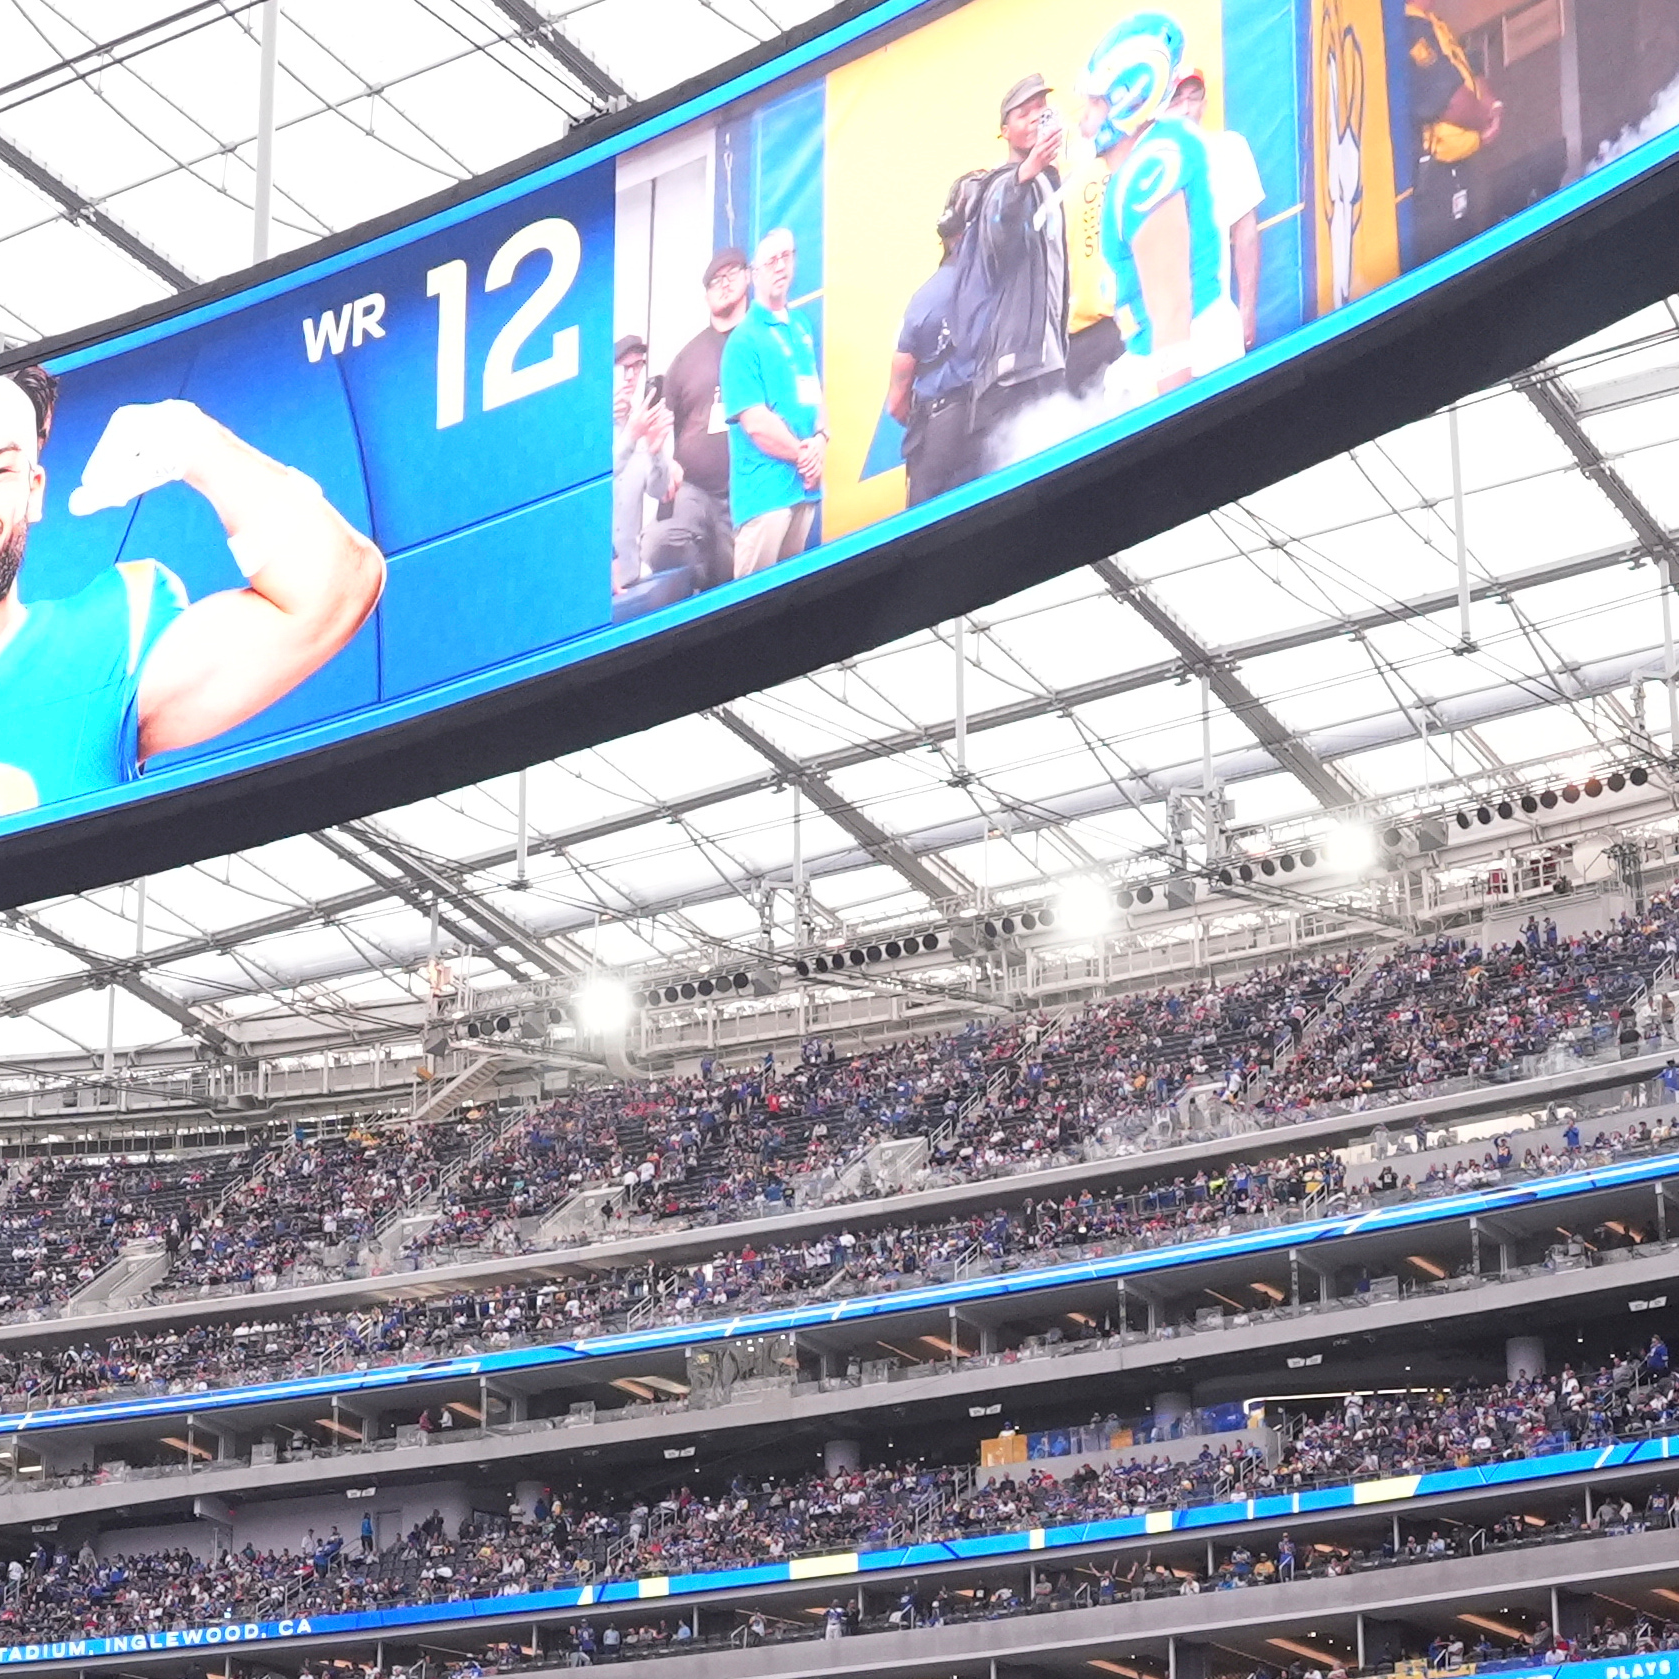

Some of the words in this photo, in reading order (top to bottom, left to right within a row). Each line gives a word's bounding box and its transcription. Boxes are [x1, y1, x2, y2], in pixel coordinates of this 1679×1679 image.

[302, 292, 386, 363] WR
[426, 217, 582, 430] 12
[278, 1619, 312, 1637] CA
